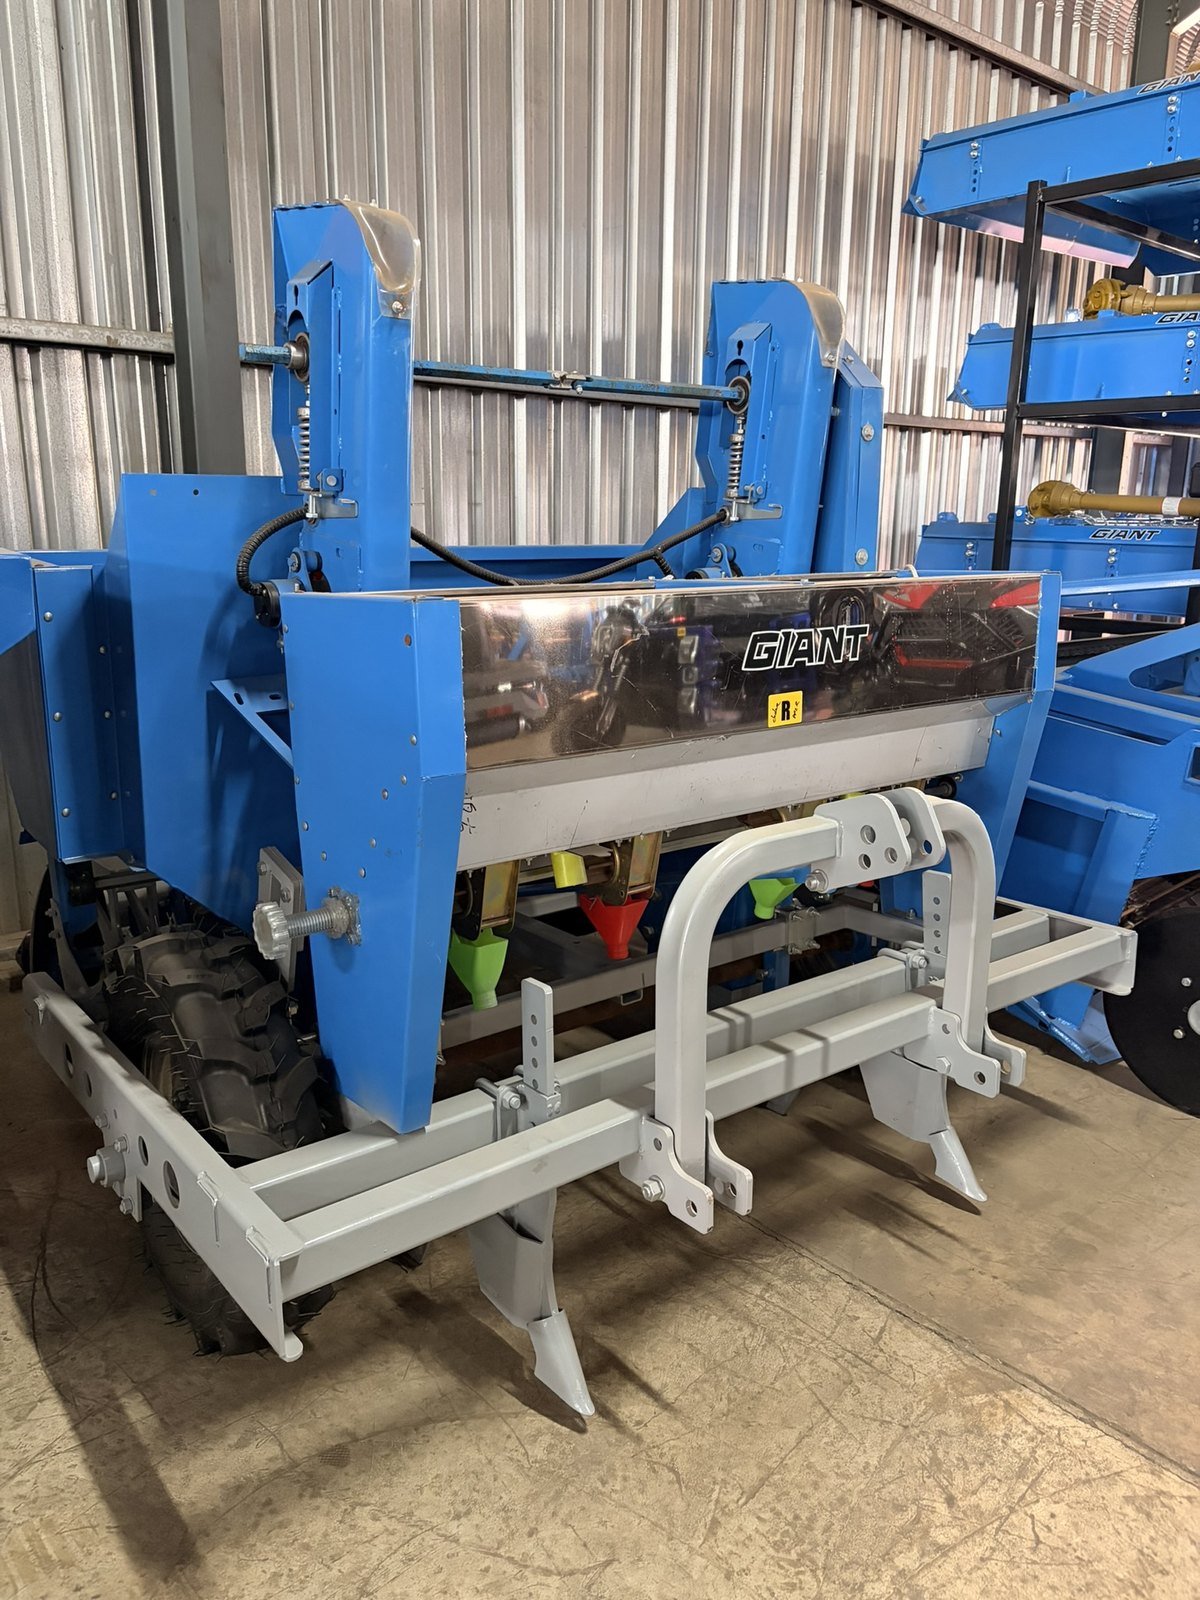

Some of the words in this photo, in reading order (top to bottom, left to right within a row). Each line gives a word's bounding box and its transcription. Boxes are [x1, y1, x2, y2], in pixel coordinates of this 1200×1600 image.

[1155, 311, 1200, 324] GIA
[1089, 528, 1161, 541] GIANT
[741, 624, 869, 671] GIANT
[781, 700, 790, 721] R
